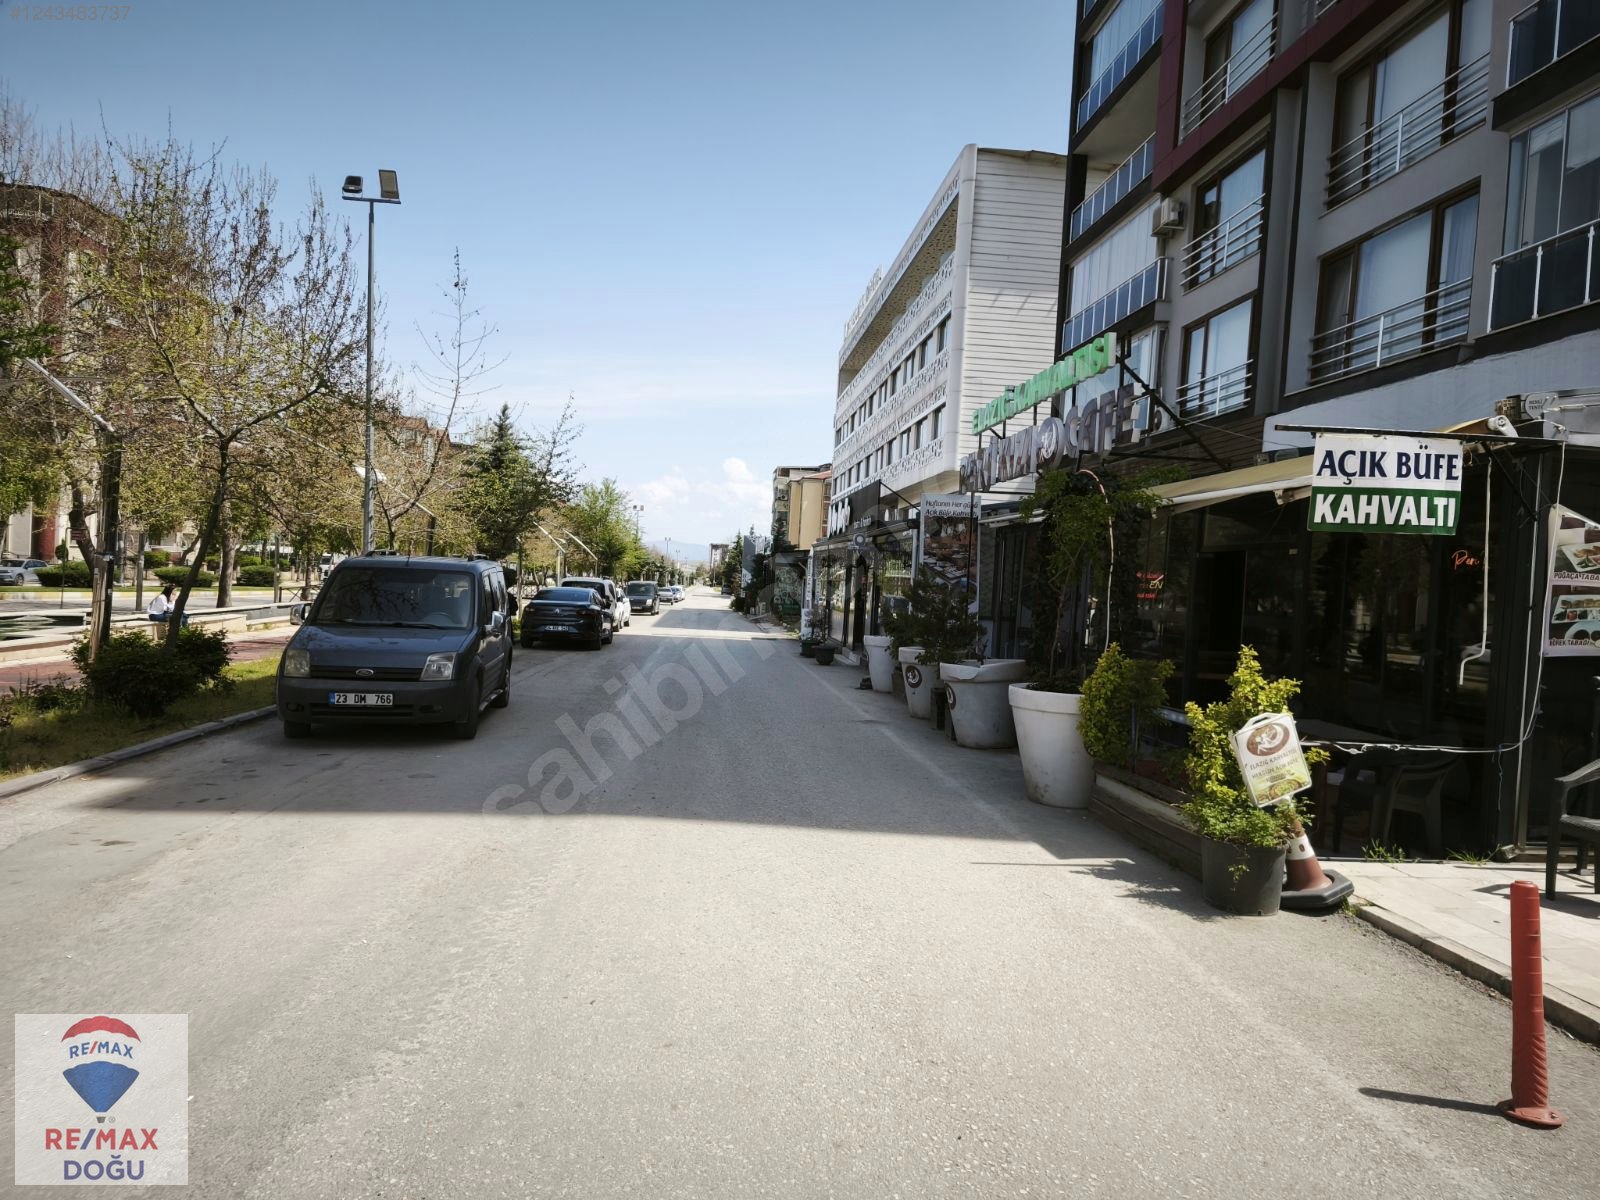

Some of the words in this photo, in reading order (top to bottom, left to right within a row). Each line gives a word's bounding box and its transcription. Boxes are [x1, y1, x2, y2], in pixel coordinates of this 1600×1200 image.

[1316, 449, 1388, 485] AÇIK
[1396, 444, 1460, 481] BÜFE
[1313, 493, 1456, 528] KAHVALTI
[336, 694, 348, 704] 23
[374, 695, 392, 704] 766
